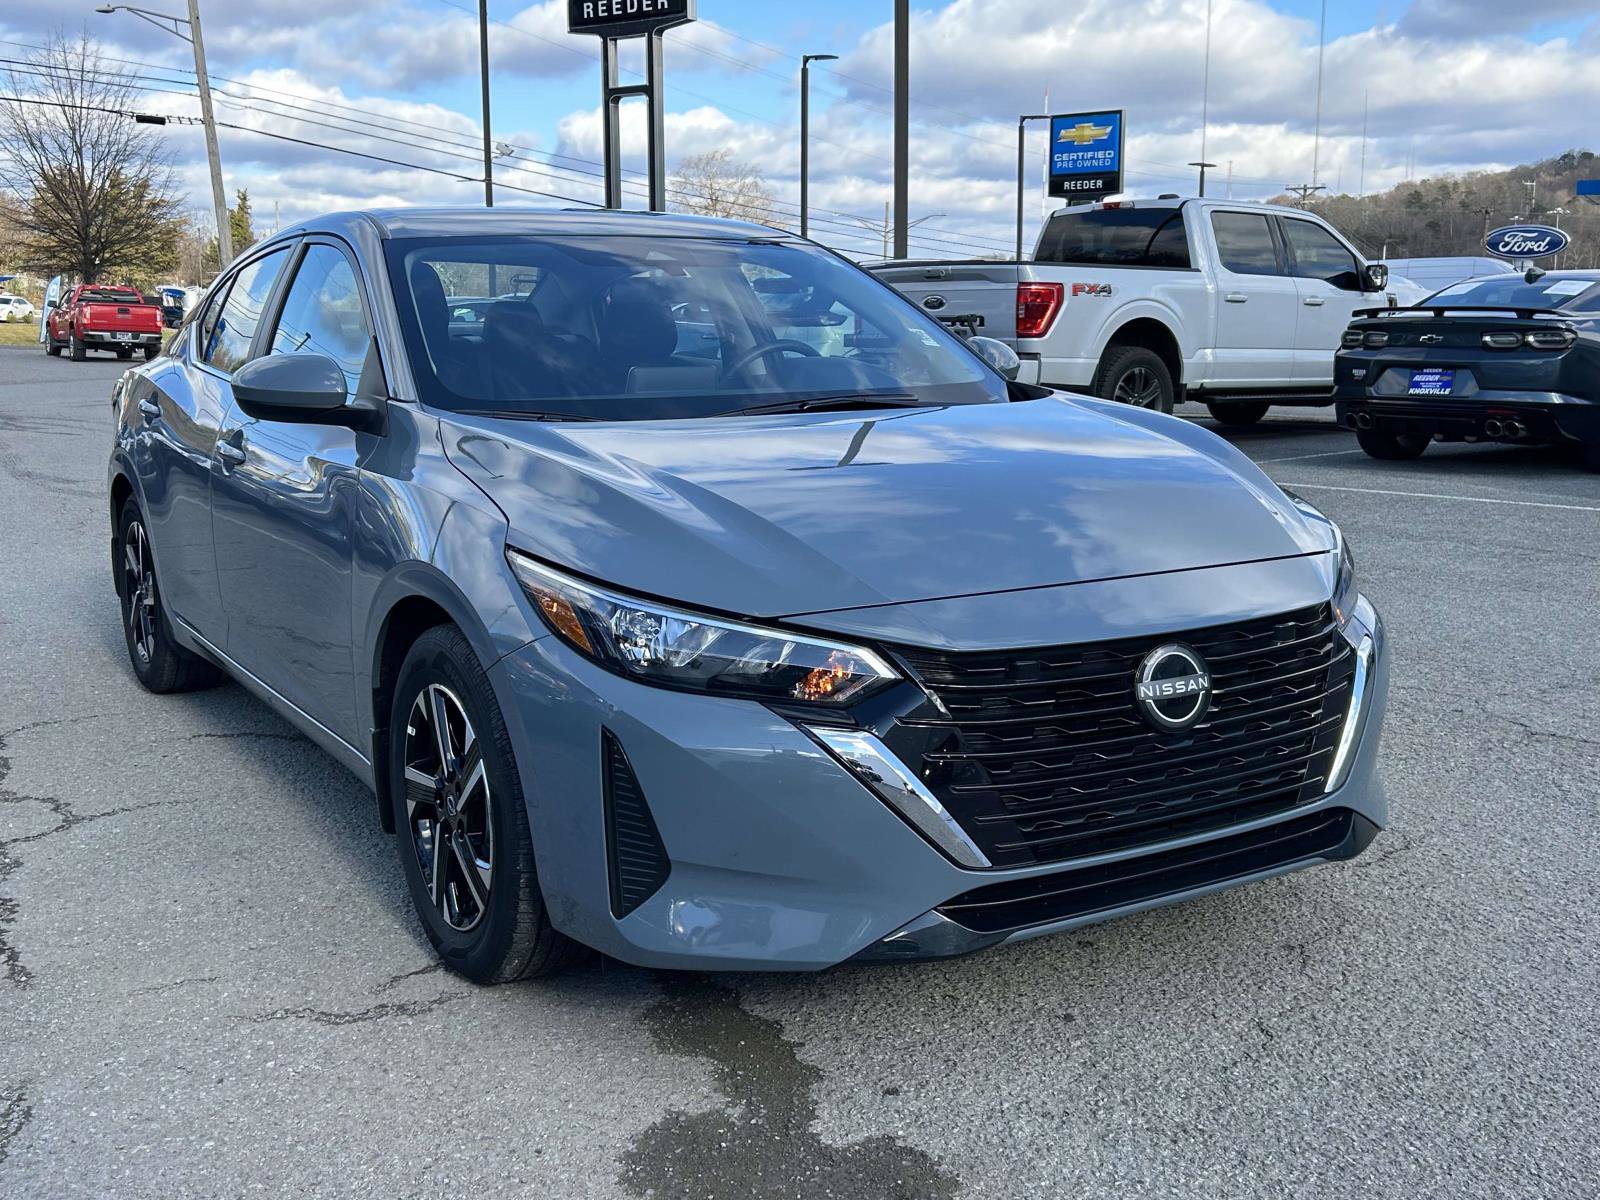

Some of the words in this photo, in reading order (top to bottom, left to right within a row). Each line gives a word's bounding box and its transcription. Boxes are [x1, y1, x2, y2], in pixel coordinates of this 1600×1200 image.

[1054, 150, 1114, 161] CERTIFIED
[1063, 180, 1103, 190] REEDER
[1498, 231, 1551, 252] Ford
[1071, 283, 1112, 296] FX4
[1408, 387, 1451, 395] KNOXVILLE
[1140, 676, 1208, 697] NISSAN
